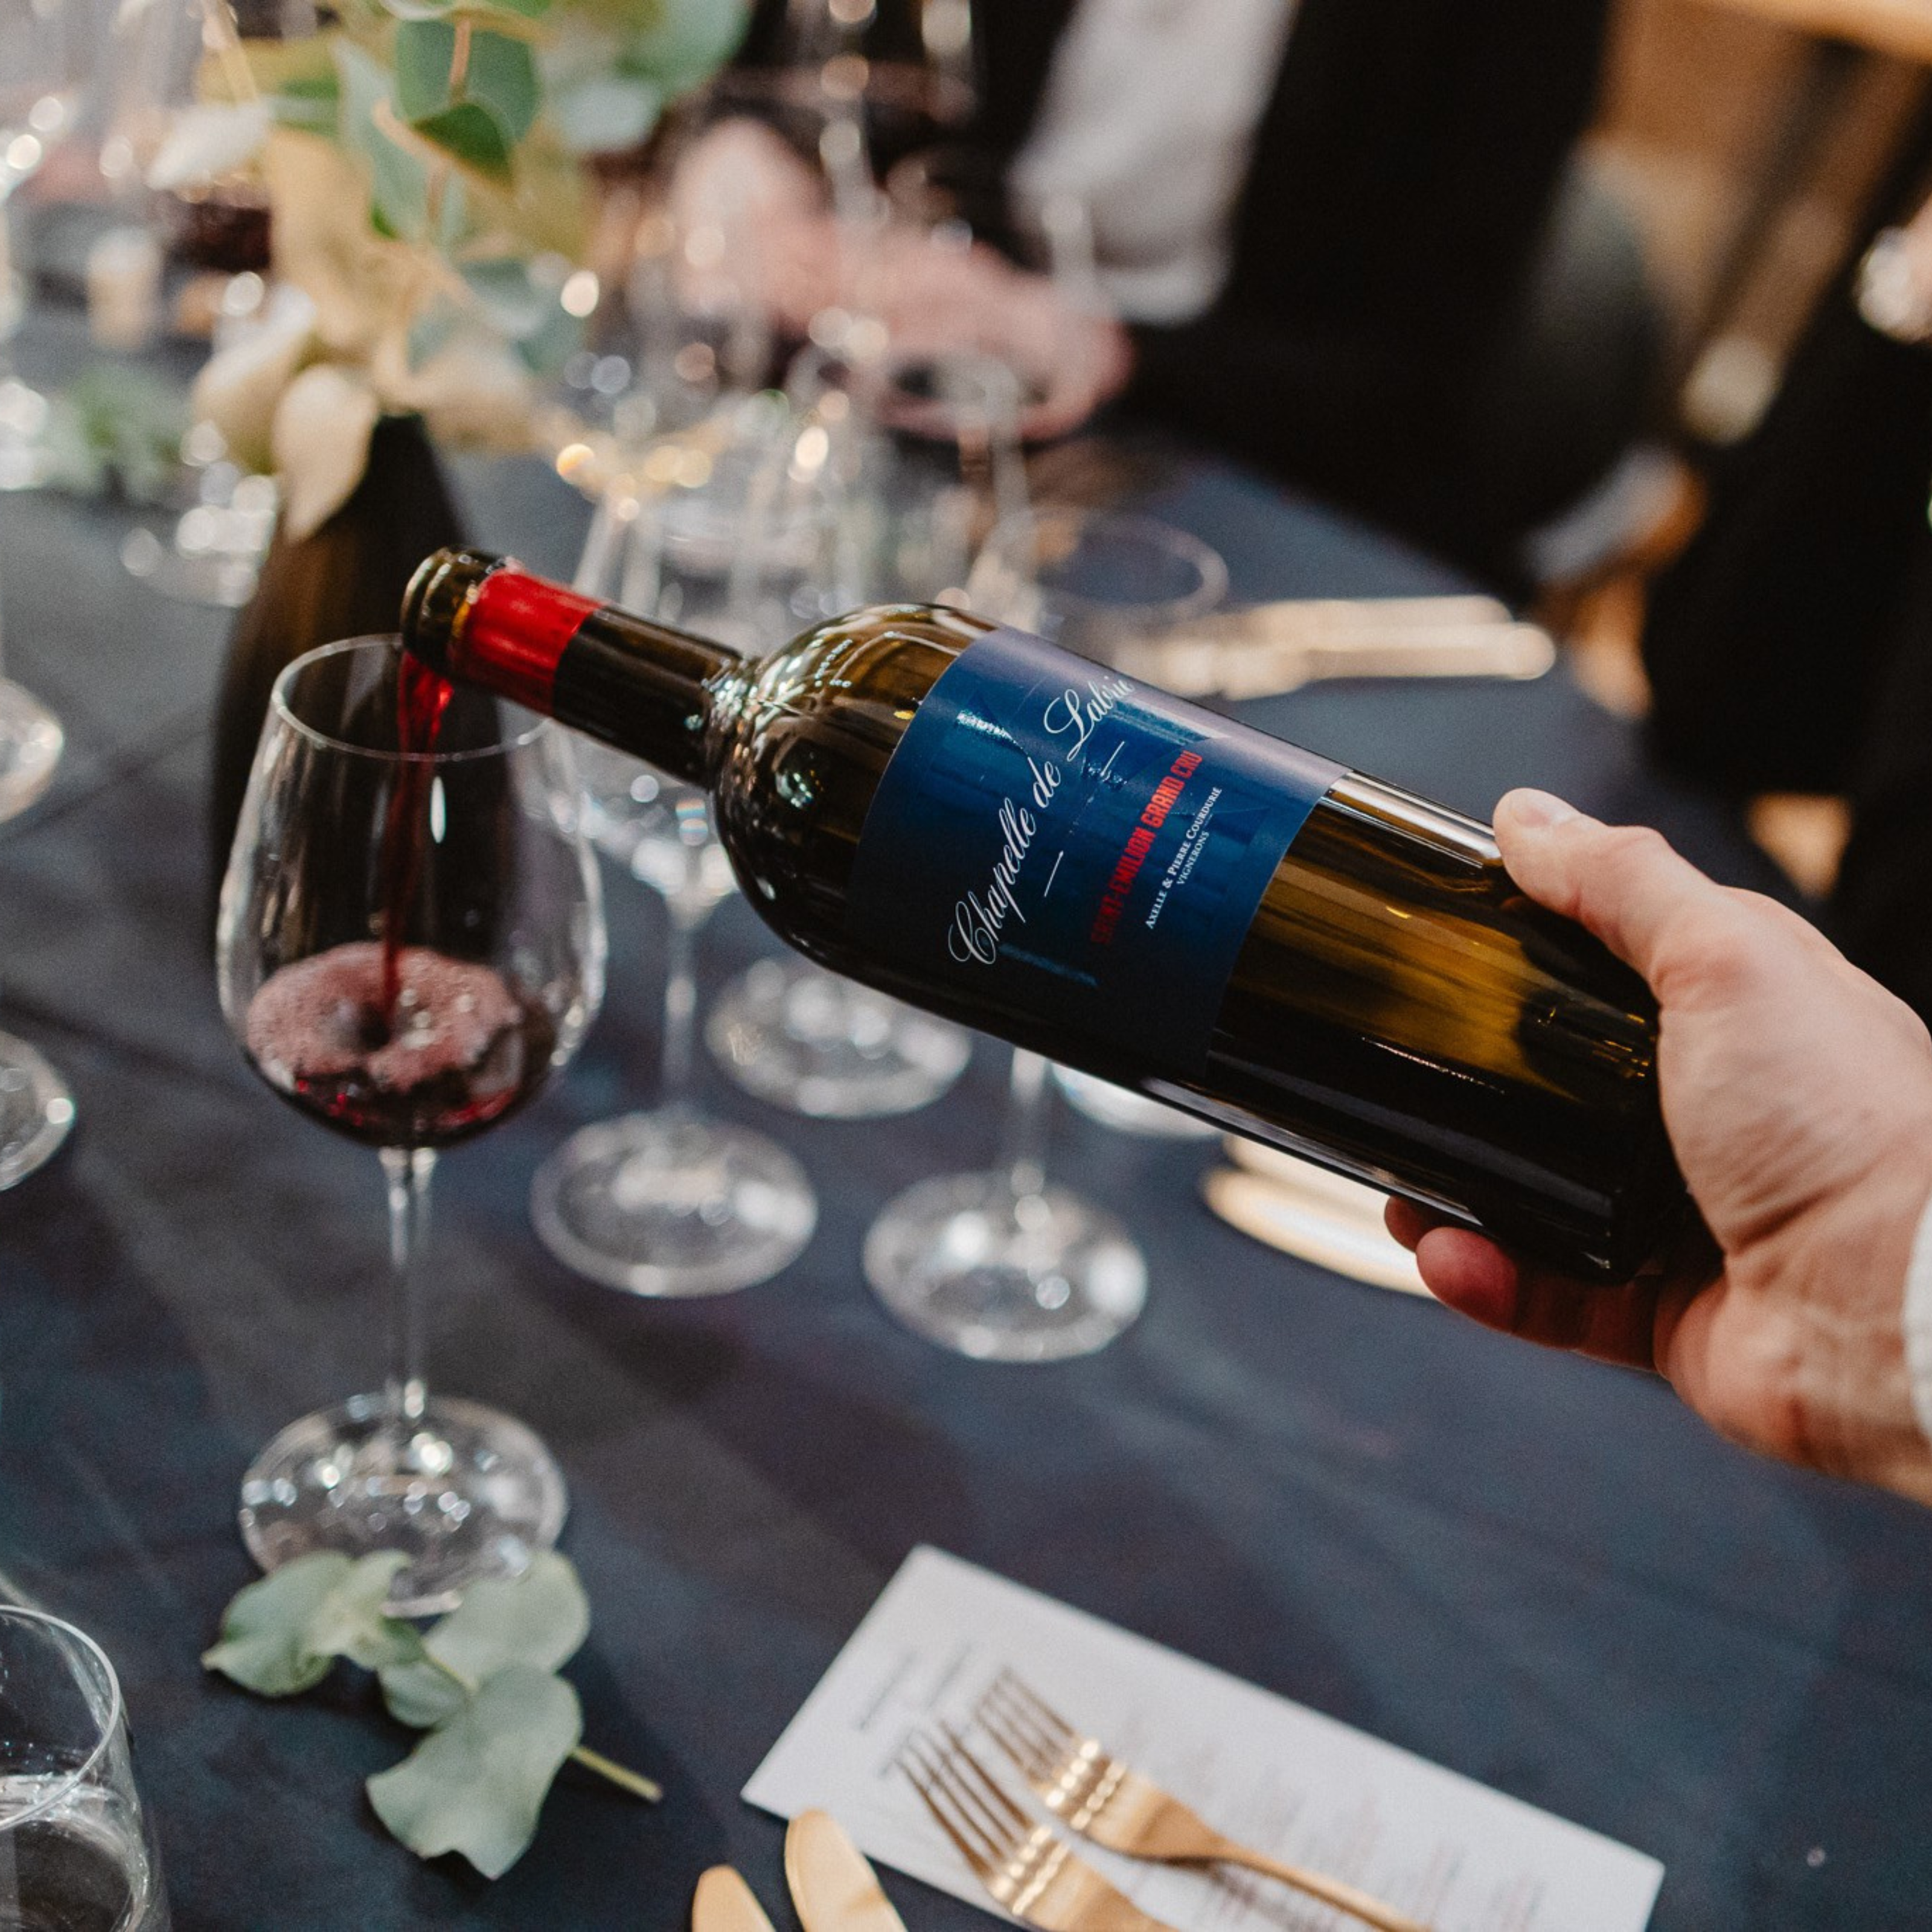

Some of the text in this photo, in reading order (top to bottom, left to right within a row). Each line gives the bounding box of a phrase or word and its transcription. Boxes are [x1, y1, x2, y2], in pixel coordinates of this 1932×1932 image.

[1140, 775, 1185, 828] GRAND
[1170, 750, 1203, 778] CRU
[948, 797, 1036, 964] Chapelle
[1028, 757, 1061, 808] de
[1167, 841, 1191, 875] PIERRE
[1177, 831, 1210, 885] VIGNERONS
[1162, 877, 1173, 889] &
[1145, 890, 1168, 929] AXELLE
